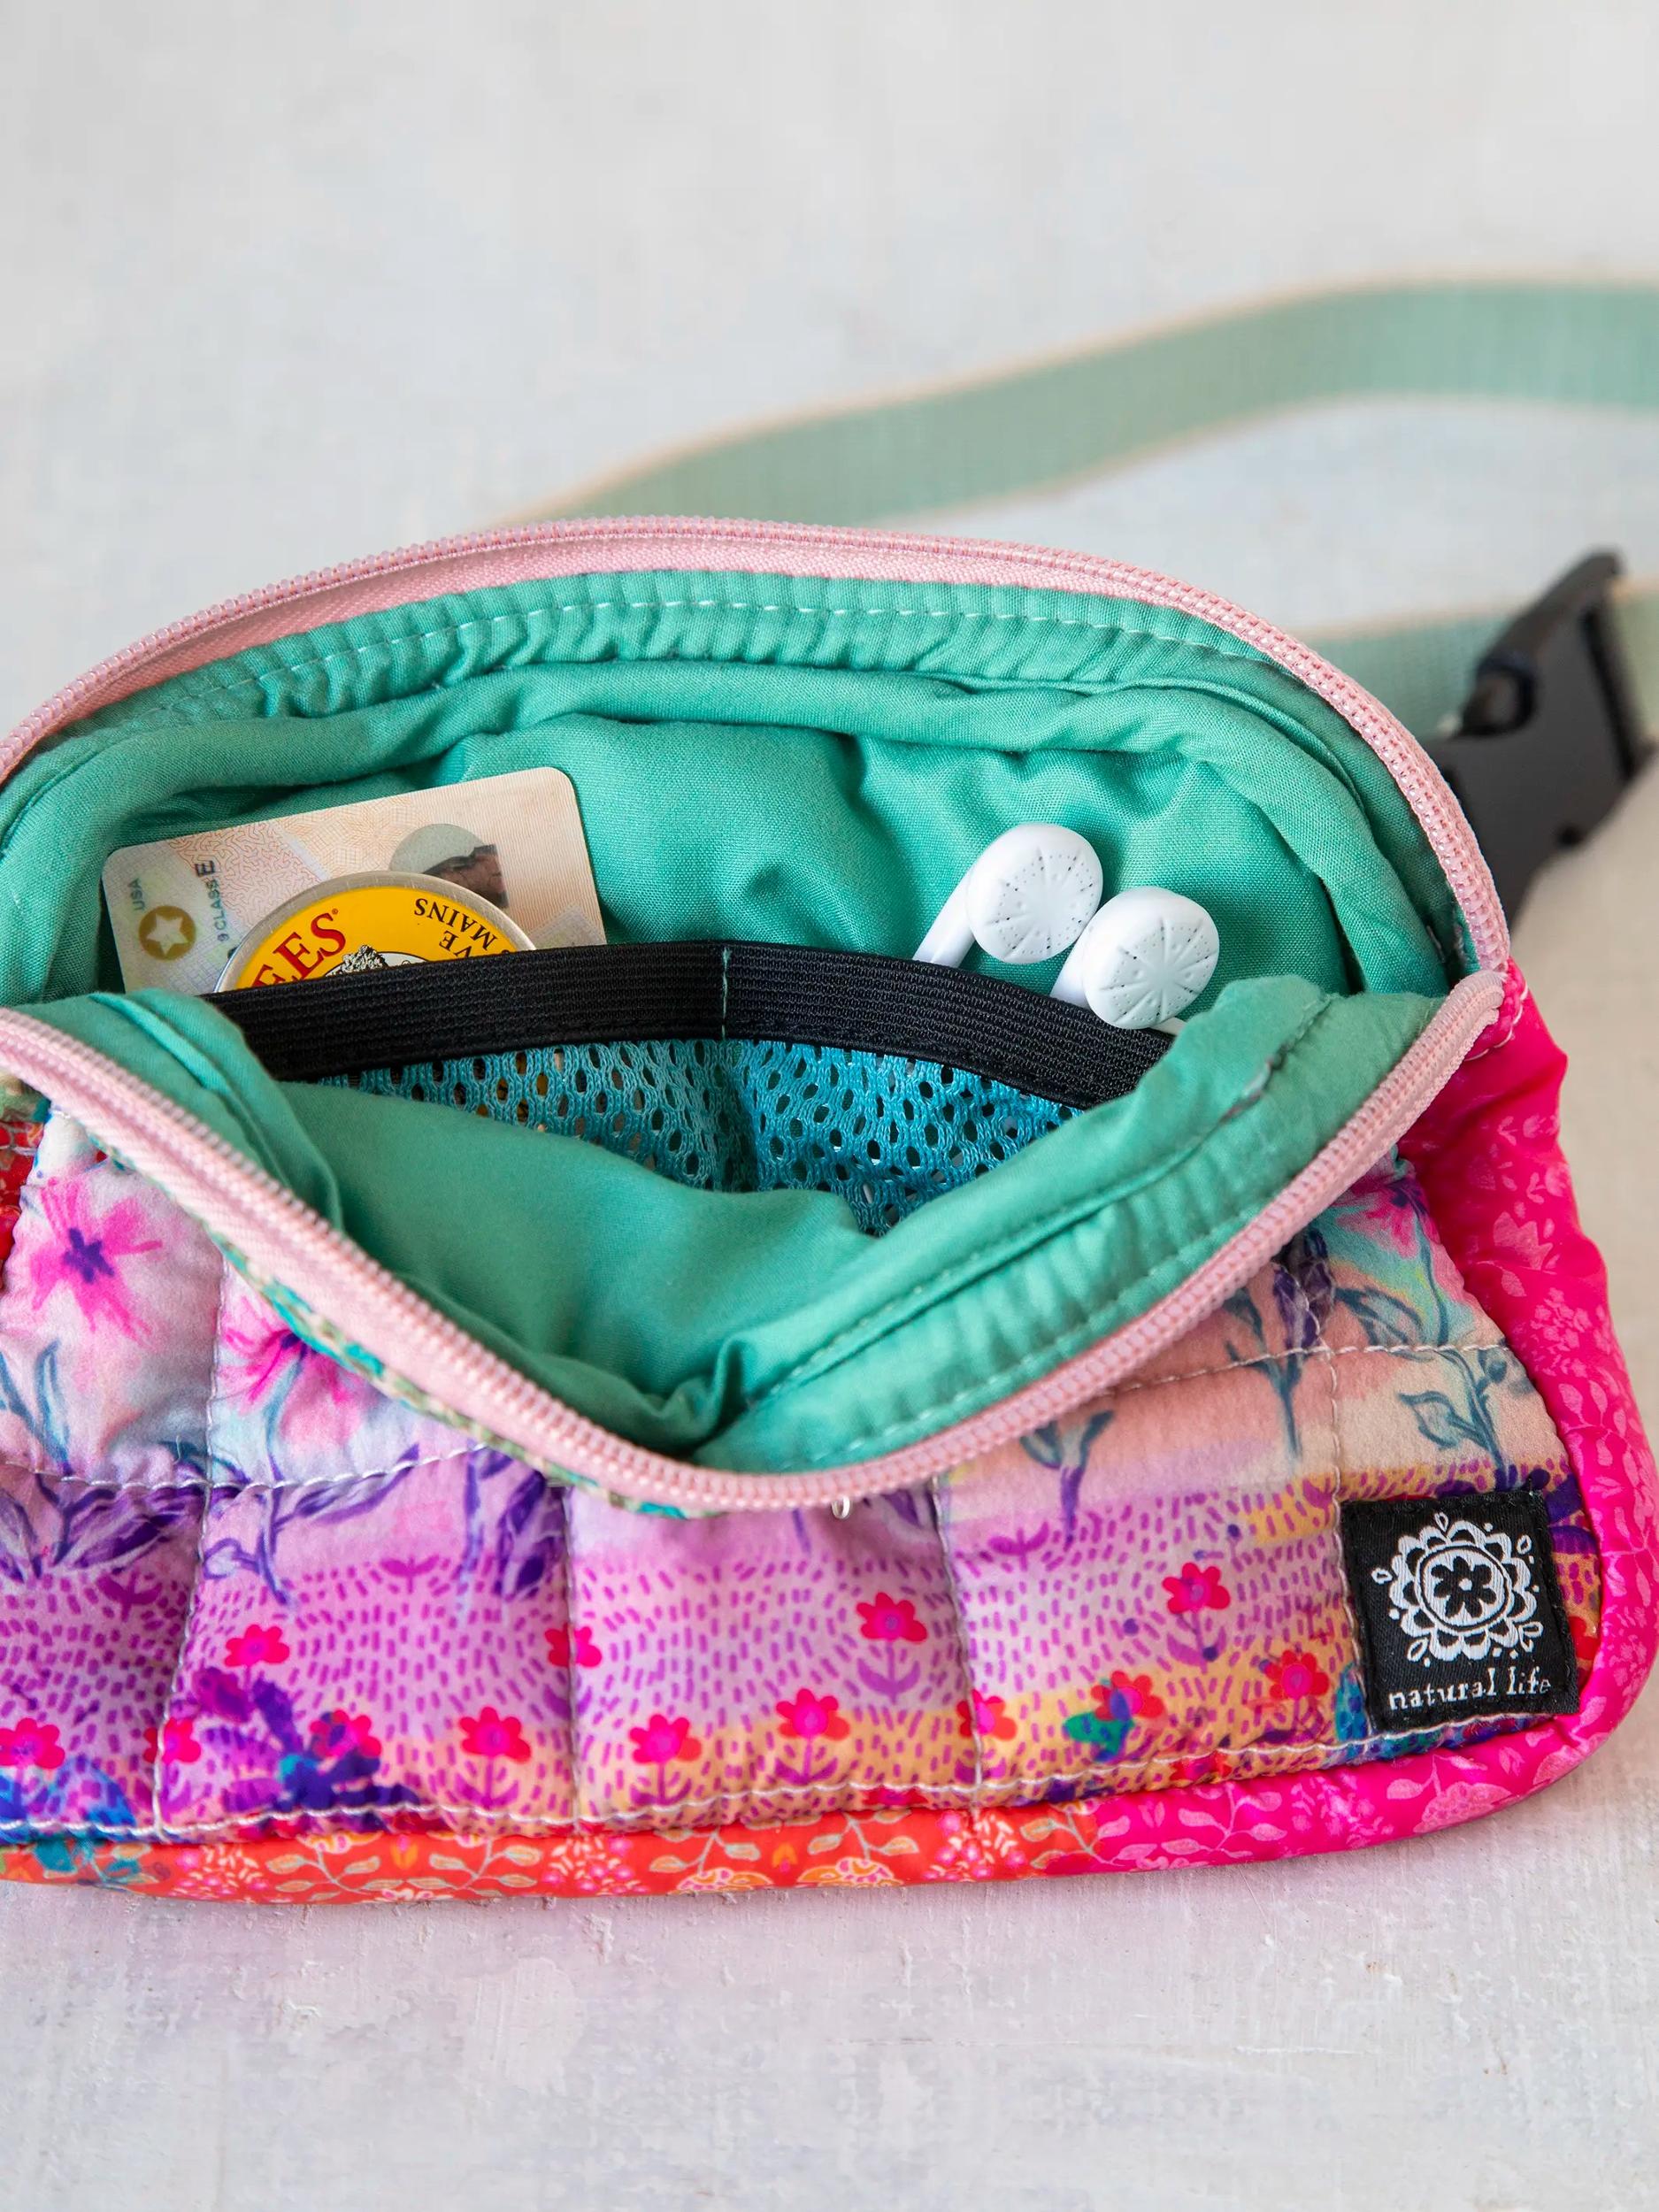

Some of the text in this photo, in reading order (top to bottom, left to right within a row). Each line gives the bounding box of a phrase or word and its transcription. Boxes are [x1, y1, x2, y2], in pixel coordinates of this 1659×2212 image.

[195, 860, 215, 877] E
[127, 877, 146, 910] USA
[205, 879, 227, 930] CLASS
[414, 898, 497, 950] MAINS
[1388, 1665, 1552, 1710] natural life
